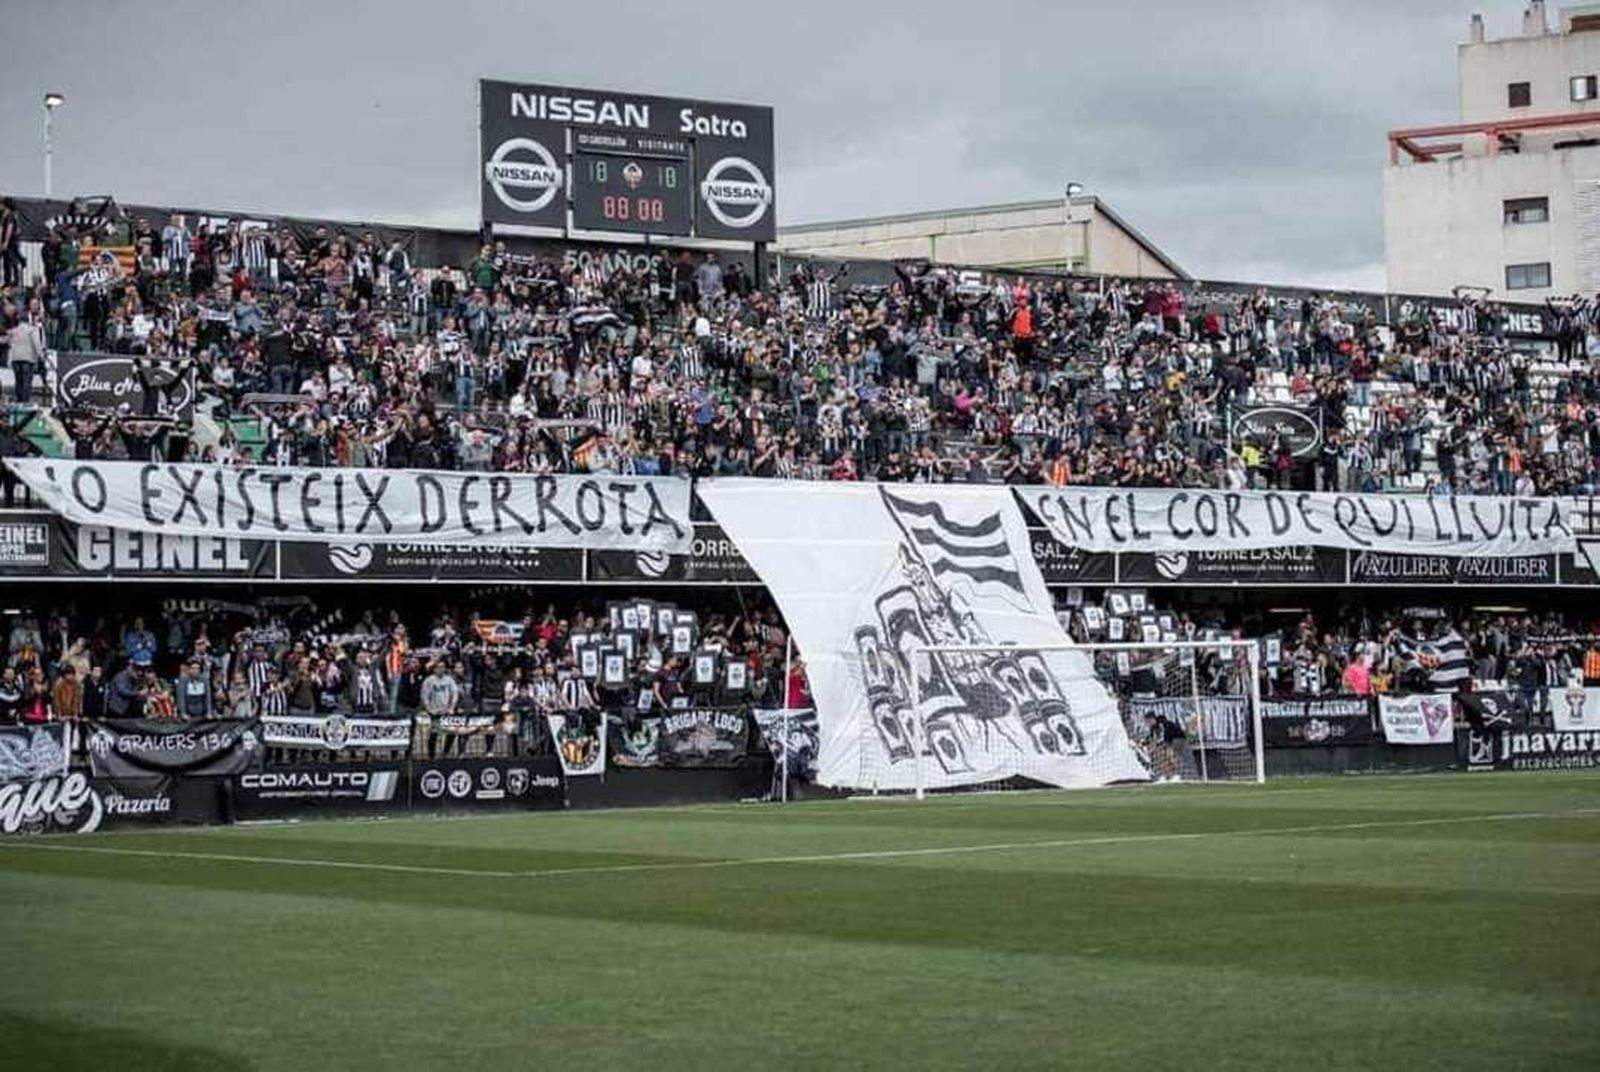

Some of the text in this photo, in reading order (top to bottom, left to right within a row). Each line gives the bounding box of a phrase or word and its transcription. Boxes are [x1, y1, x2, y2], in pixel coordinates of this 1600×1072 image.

[510, 92, 650, 128] NISSAN
[679, 108, 748, 138] Satra
[492, 164, 556, 184] NISSAN
[706, 184, 766, 201] NISSAN
[70, 374, 142, 398] Blue No
[140, 465, 393, 535] EXISTEIX
[416, 474, 685, 540] DERROTA
[1039, 494, 1095, 541] EN
[1105, 492, 1152, 543] EL
[1167, 492, 1250, 538] COR
[1263, 492, 1323, 537] DE
[77, 526, 251, 571] GEINEL
[1034, 542, 1066, 559] SAL
[1272, 546, 1302, 560] SAL
[715, 711, 743, 734] LOCO
[241, 772, 368, 788] COMAUTO
